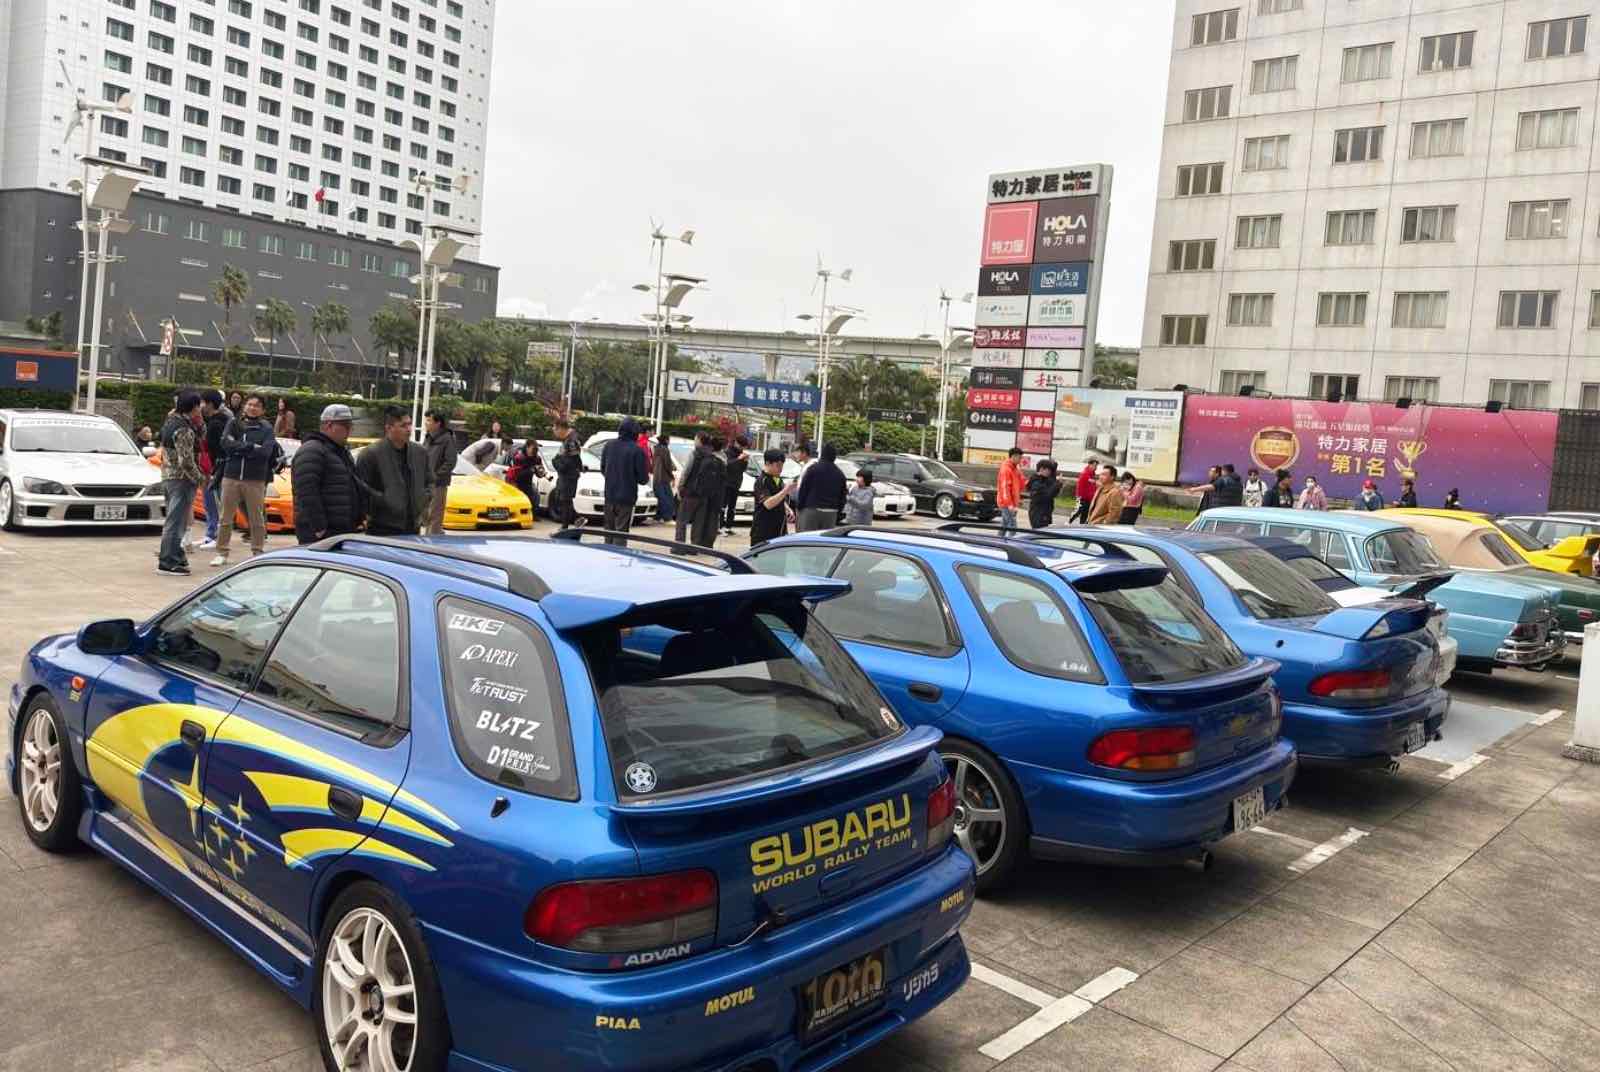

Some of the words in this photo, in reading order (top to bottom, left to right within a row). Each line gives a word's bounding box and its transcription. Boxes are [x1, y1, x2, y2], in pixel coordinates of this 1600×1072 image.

[992, 174, 1060, 198] 特力家居
[1043, 214, 1087, 232] HOLA
[990, 271, 1019, 284] HOLA
[744, 385, 812, 405] 電動車充電站
[1318, 436, 1388, 454] 特力家居
[1331, 455, 1386, 478] 第1名
[448, 613, 505, 636] HKS
[480, 685, 528, 704] TRUST
[476, 710, 541, 740] BLITZ
[486, 745, 510, 767] D1
[508, 749, 534, 762] GRAND
[750, 793, 912, 876] SUBARU
[752, 863, 817, 894] WORLD
[824, 844, 871, 870] RALLY
[875, 828, 912, 849] TEAM
[624, 943, 691, 967] ADVAN
[704, 986, 755, 1016] MOTUL
[595, 1015, 641, 1030] PIAA
